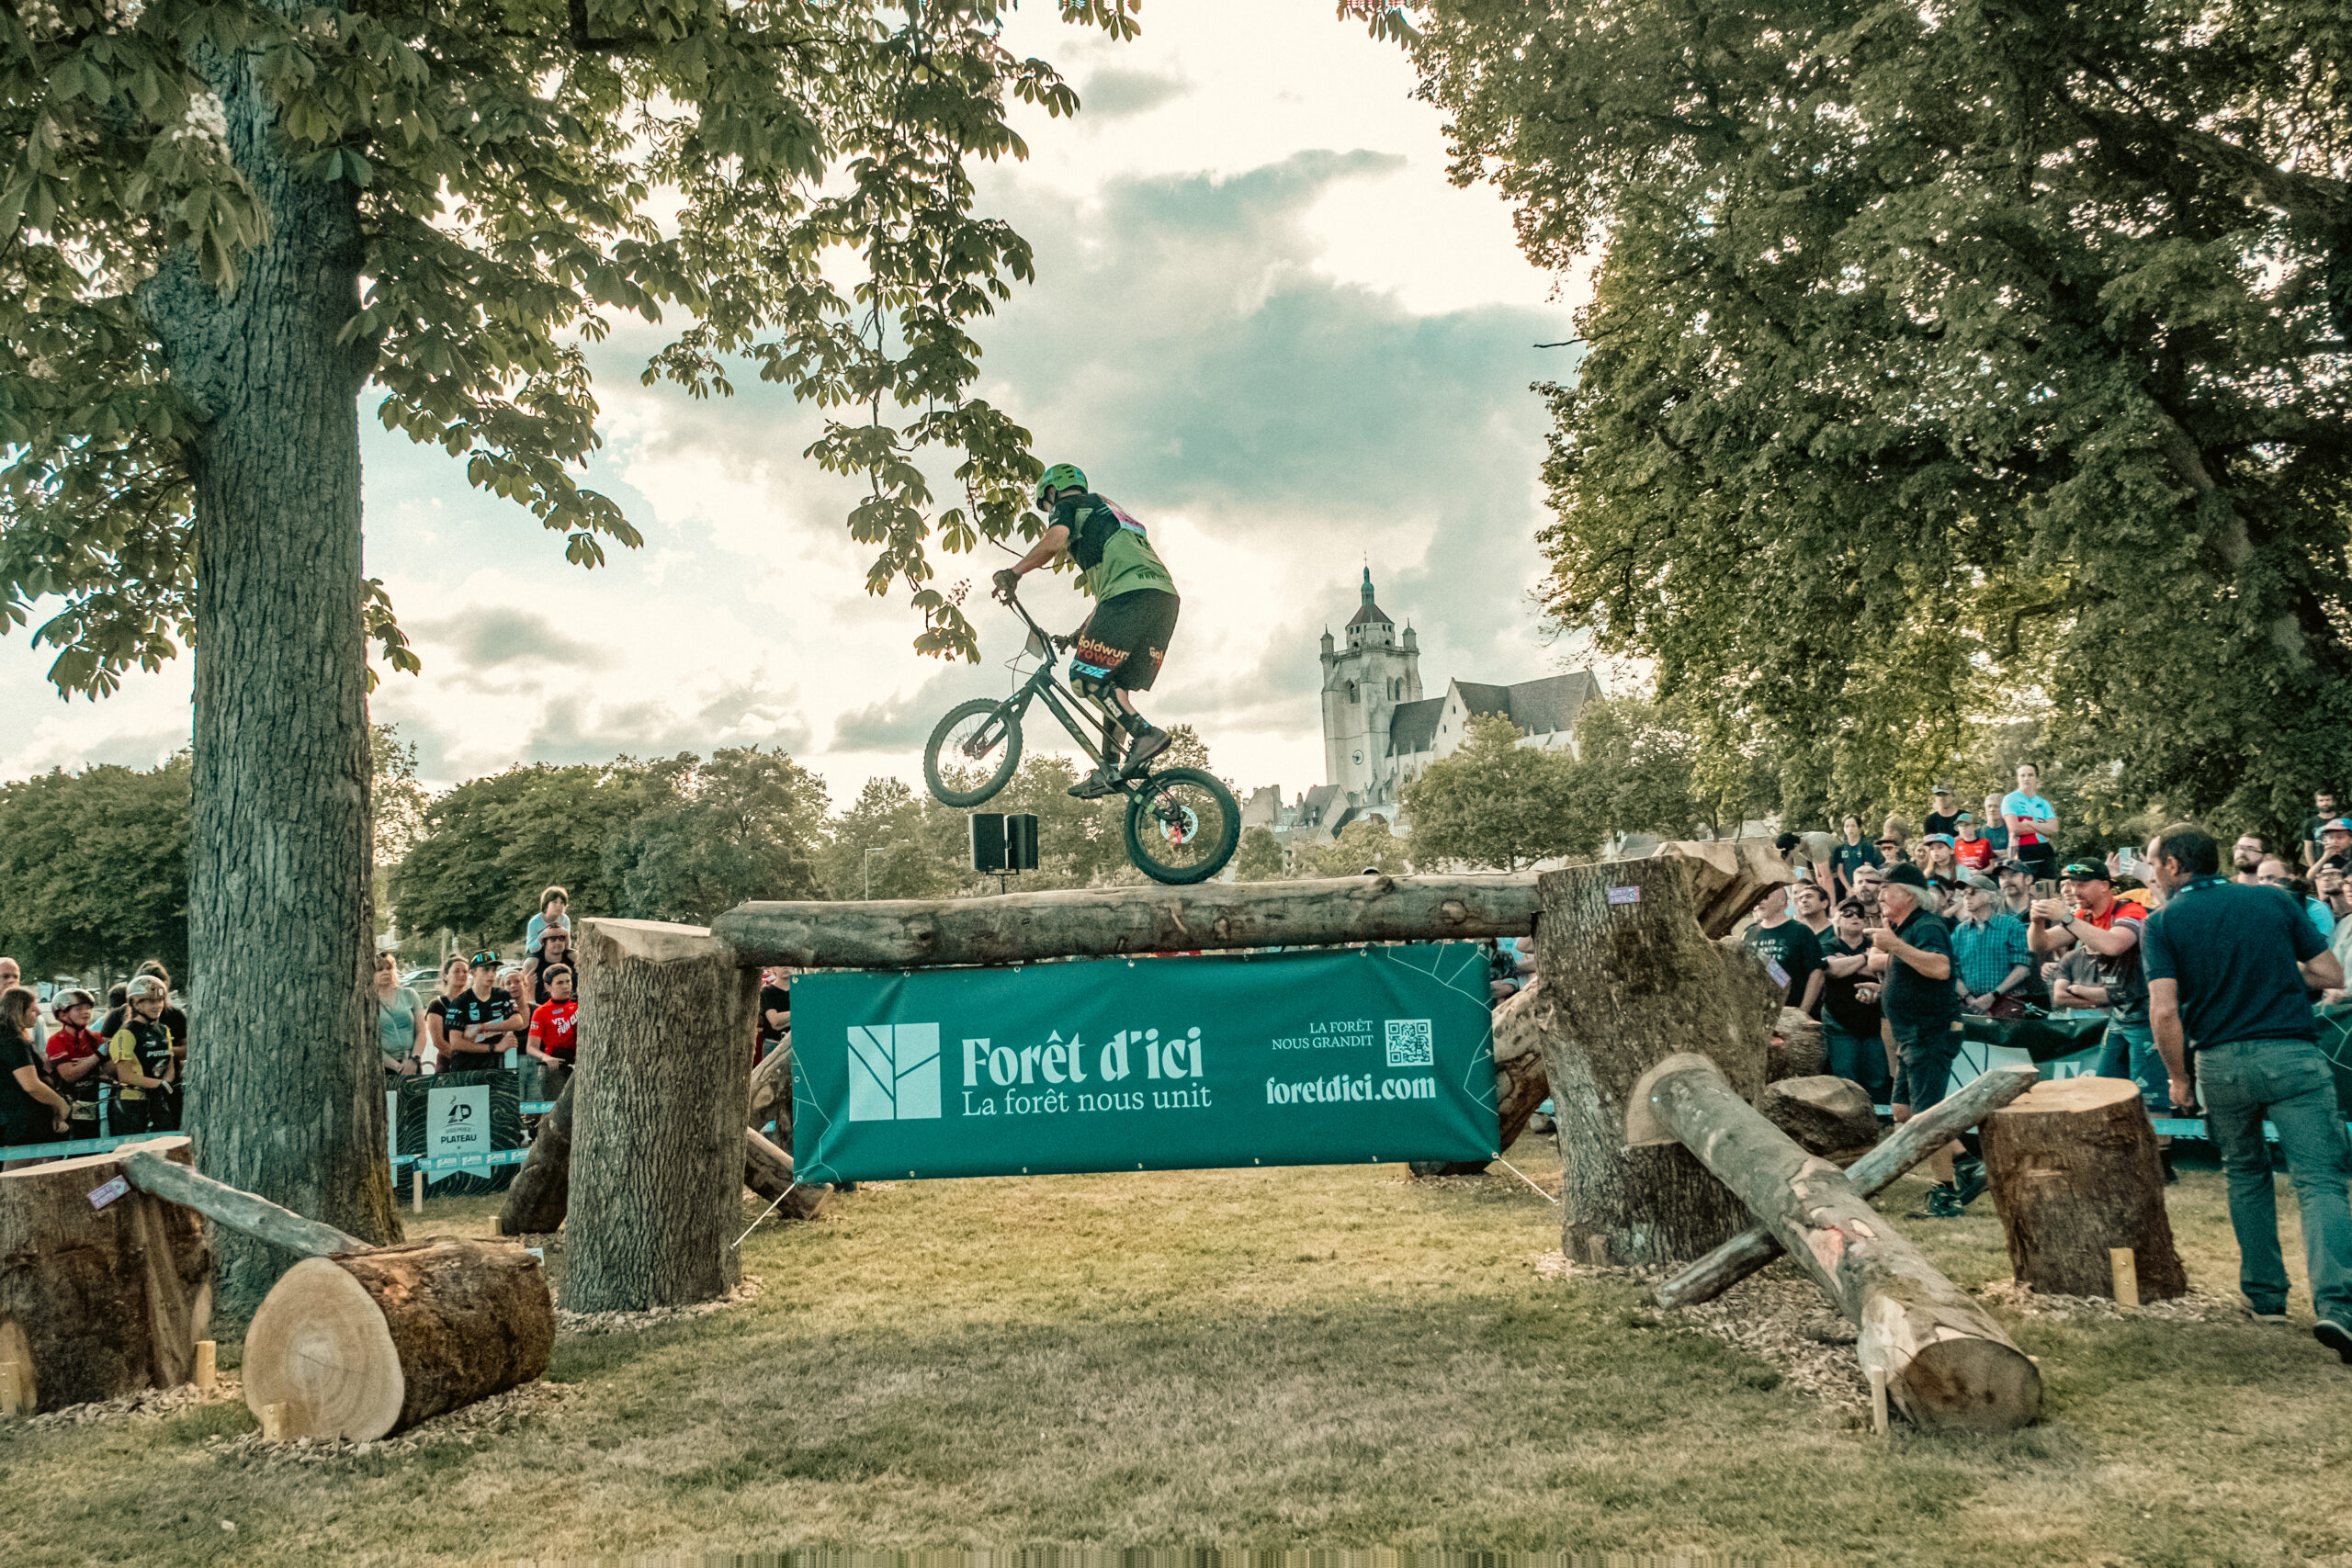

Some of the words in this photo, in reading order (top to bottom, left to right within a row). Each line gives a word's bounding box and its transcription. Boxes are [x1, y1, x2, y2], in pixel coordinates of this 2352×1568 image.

[1309, 1021, 1327, 1034] LA
[1329, 1018, 1374, 1033] FORÊT
[1272, 1037, 1310, 1050] NOUS
[1312, 1034, 1374, 1049] GRANDIT
[962, 1029, 1088, 1087] Forêt
[1100, 1026, 1204, 1082] d'ici
[962, 1090, 997, 1116] La
[1004, 1088, 1069, 1115] forêt
[1078, 1089, 1145, 1112] nous
[1151, 1082, 1212, 1110] unit
[1266, 1073, 1437, 1105] foretdici.com
[440, 1134, 477, 1145] PLATEAU
